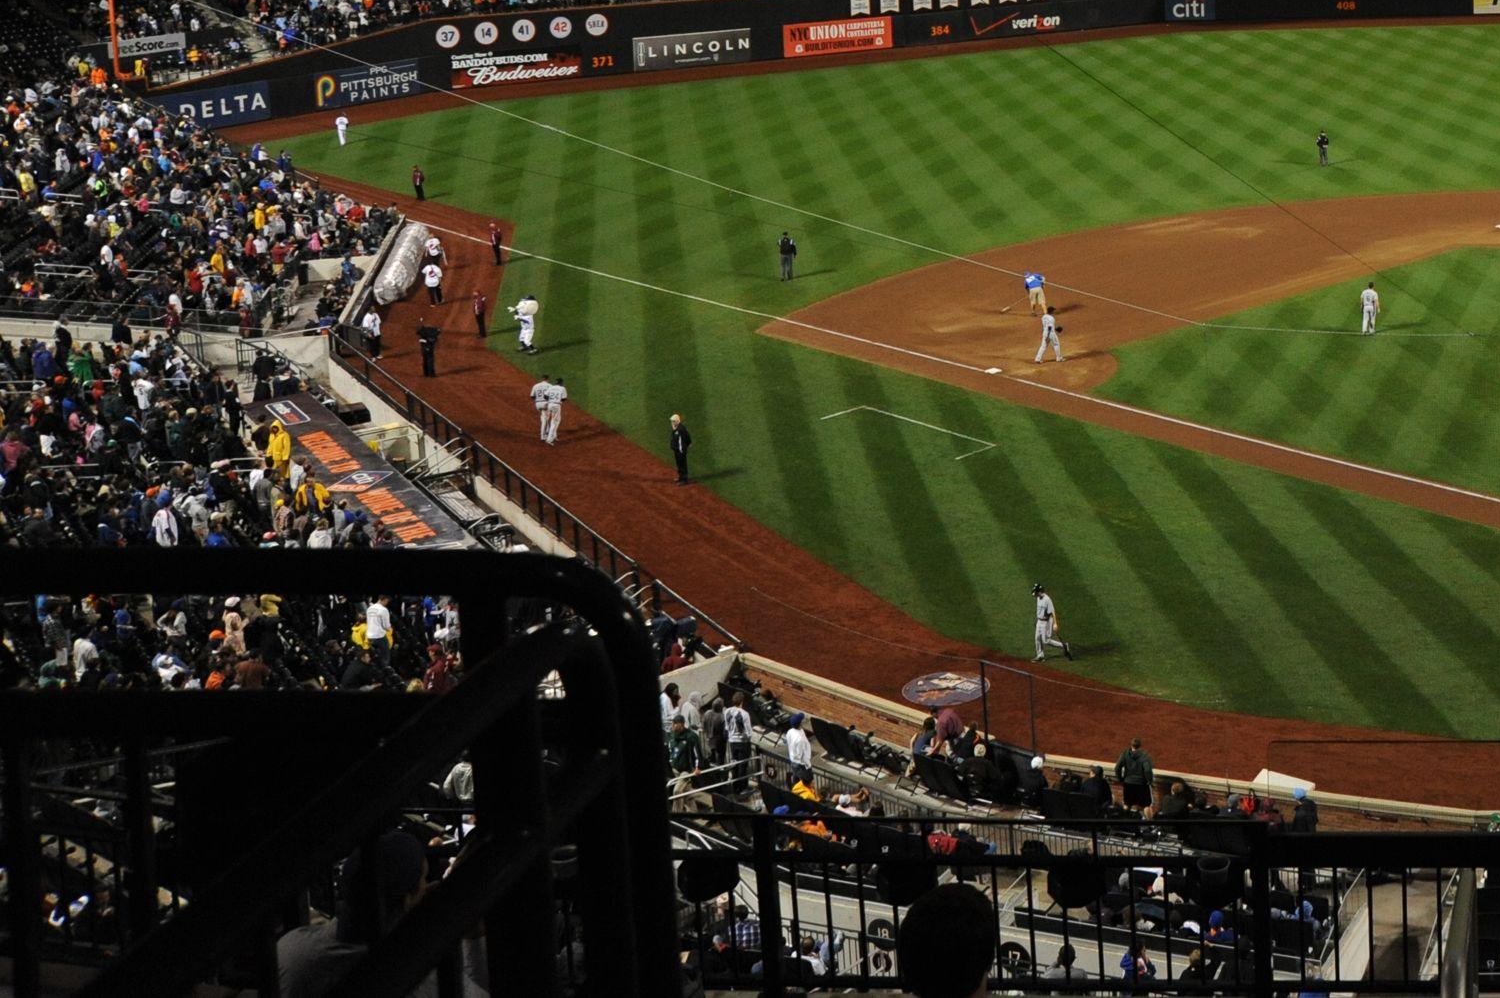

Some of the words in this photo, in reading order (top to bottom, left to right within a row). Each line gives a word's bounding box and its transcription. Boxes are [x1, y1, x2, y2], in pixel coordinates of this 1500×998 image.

[1336, 1, 1356, 10] 408
[517, 24, 530, 36] 41
[553, 21, 568, 33] 42
[1012, 15, 1061, 30] verizon
[441, 31, 456, 43] 37
[481, 27, 492, 39] 14
[790, 27, 810, 42] NYC
[810, 23, 846, 40] UNION
[930, 26, 950, 36] 384
[120, 39, 179, 54] reeScore.com
[648, 38, 750, 58] LINCOLN
[451, 53, 548, 69] BANDOFBUDS.COM
[592, 56, 613, 68] 371
[369, 65, 388, 76] PPG
[467, 63, 579, 86] Budweiser
[340, 70, 418, 93] PITTSBURGH
[350, 82, 410, 102] PAINTS
[179, 92, 267, 119] DELTA
